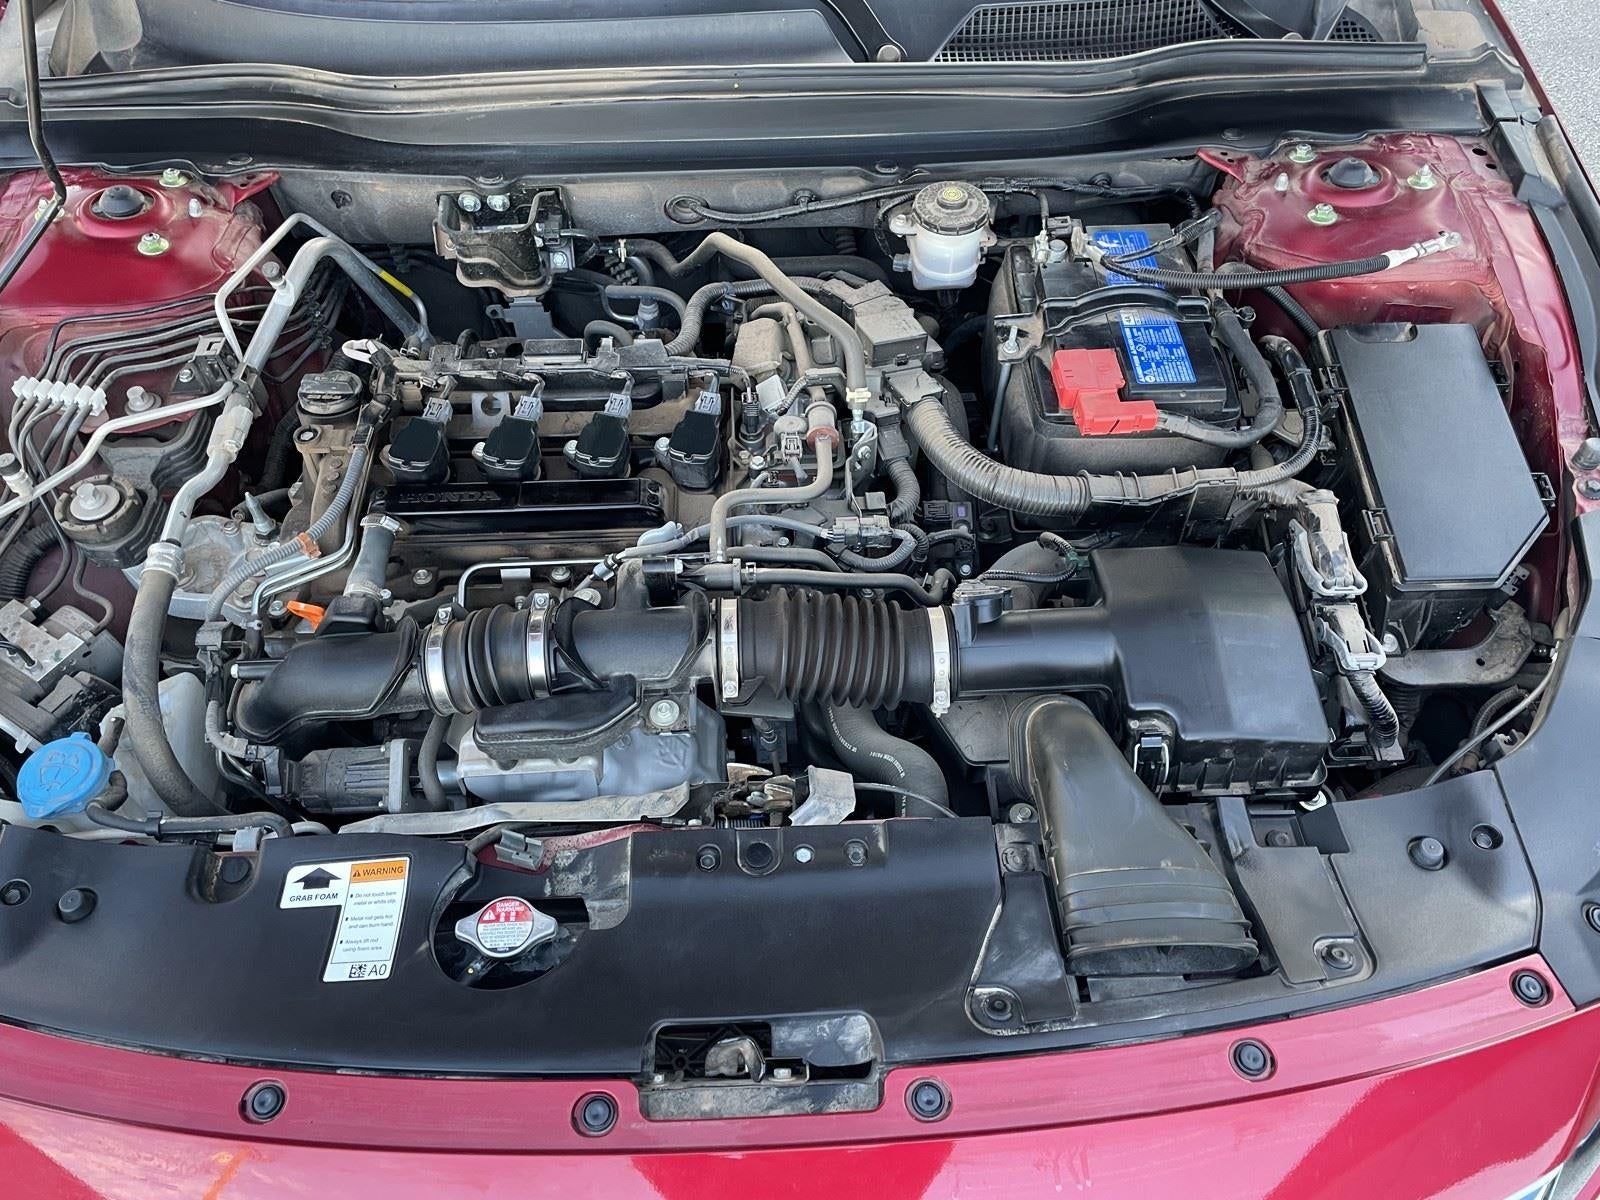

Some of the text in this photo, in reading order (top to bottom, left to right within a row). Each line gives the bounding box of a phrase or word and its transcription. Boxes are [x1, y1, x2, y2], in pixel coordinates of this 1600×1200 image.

[399, 491, 501, 503] HONDA
[363, 866, 404, 876] WARNING
[368, 964, 387, 977] A0
